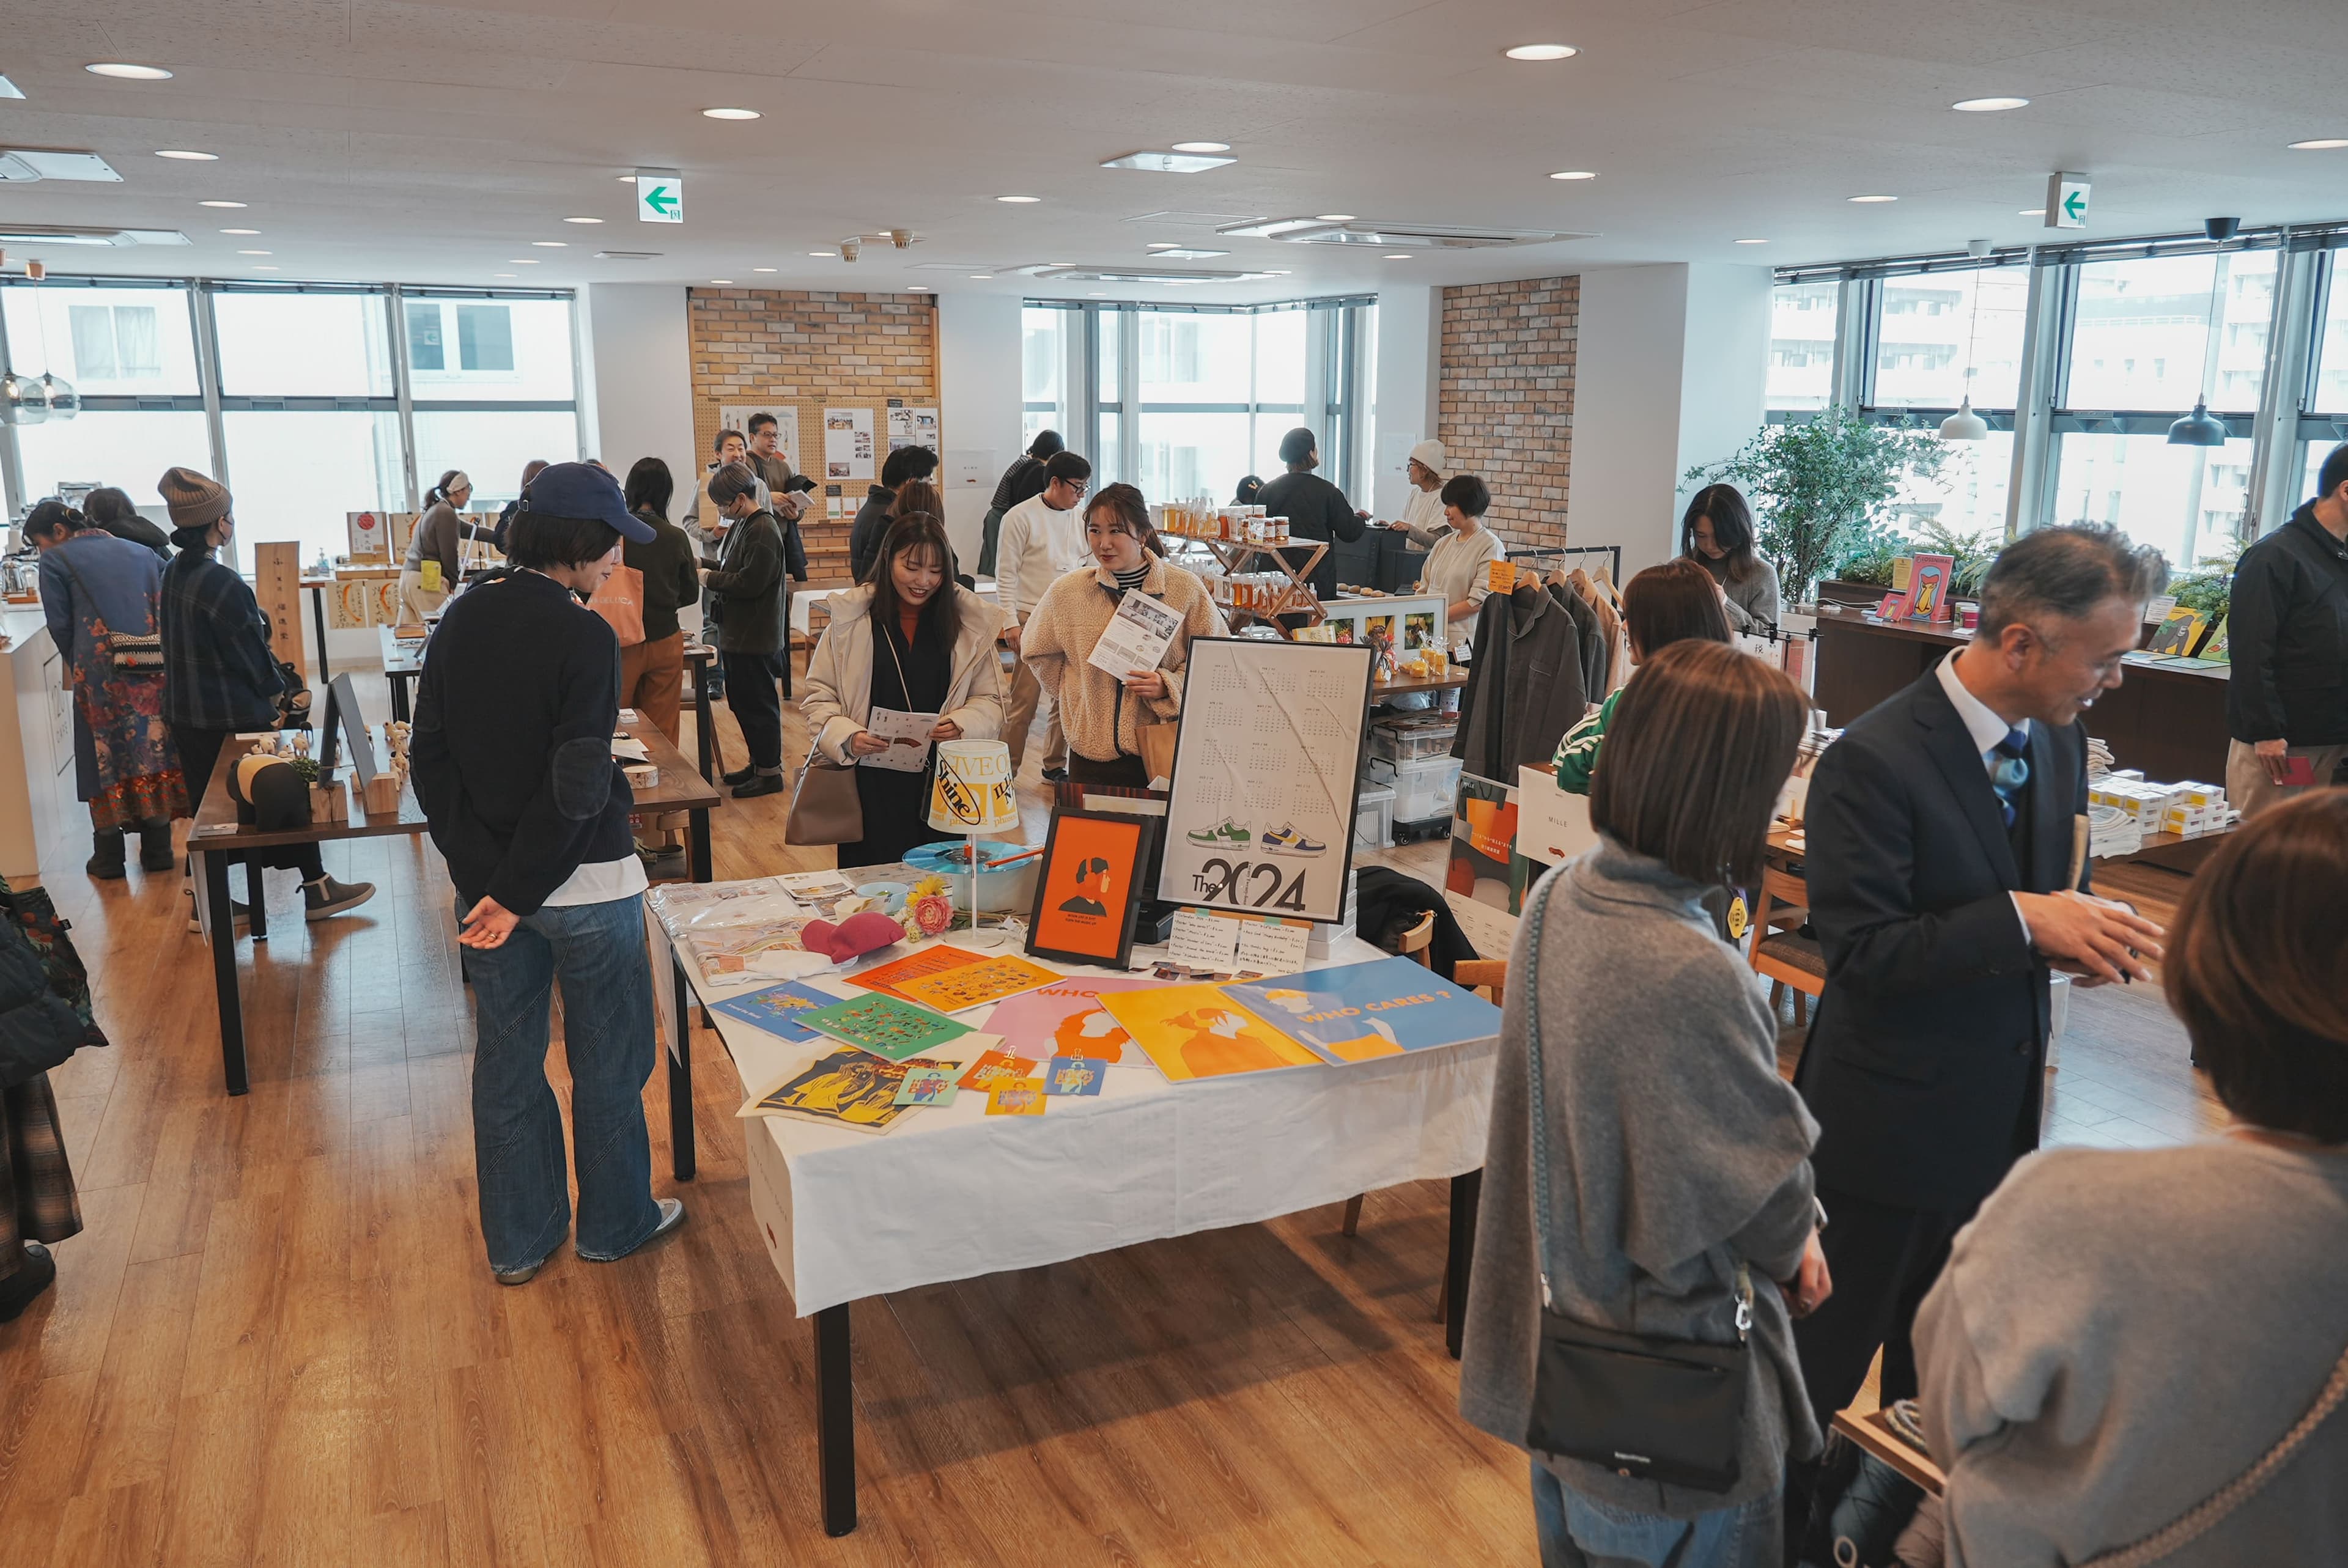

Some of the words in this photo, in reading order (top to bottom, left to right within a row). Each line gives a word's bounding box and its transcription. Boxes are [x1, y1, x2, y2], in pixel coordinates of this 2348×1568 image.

[937, 759, 970, 817] Shine
[1548, 816, 1568, 828] MILLE
[1192, 874, 1216, 893] The
[1202, 858, 1306, 911] 2024
[1036, 988, 1099, 998] WHO
[1296, 1007, 1360, 1023] WHO
[1365, 993, 1435, 1011] CARES
[1436, 990, 1452, 999] ?
